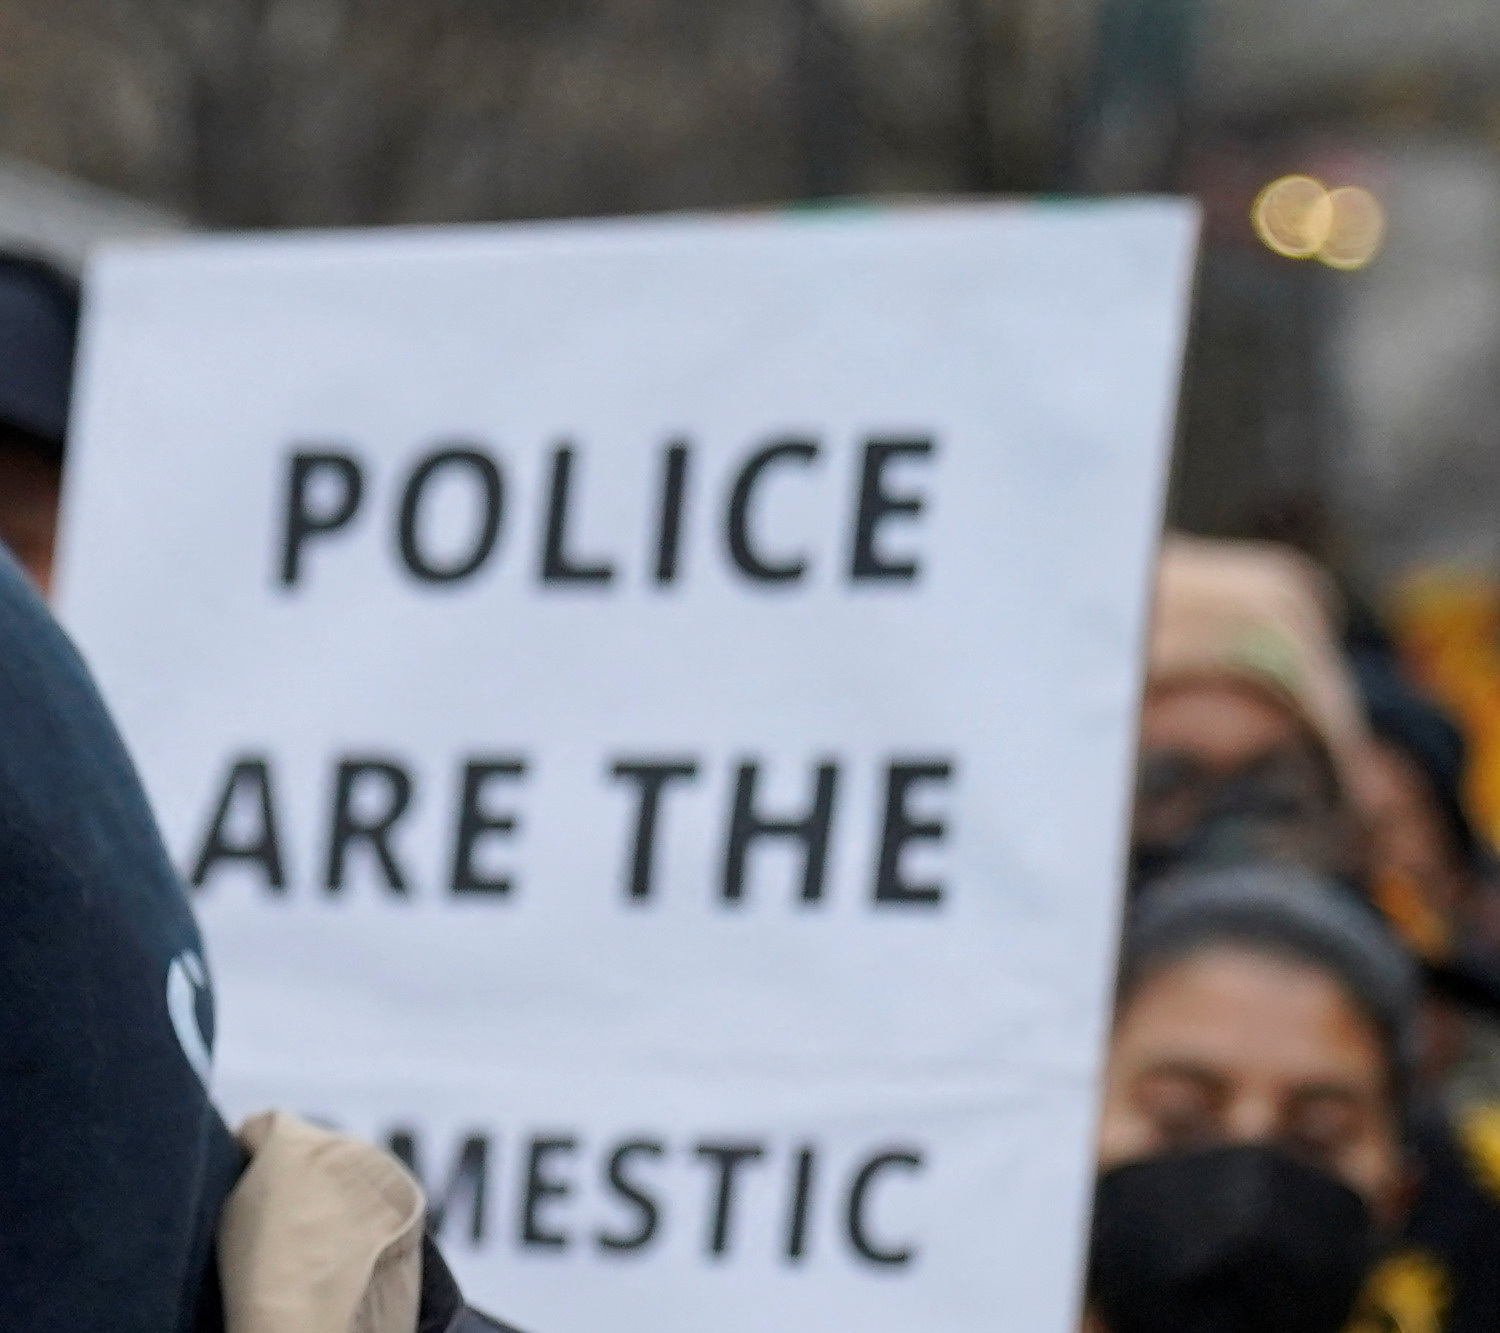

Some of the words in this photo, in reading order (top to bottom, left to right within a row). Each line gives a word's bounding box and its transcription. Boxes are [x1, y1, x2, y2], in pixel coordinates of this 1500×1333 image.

[277, 432, 936, 590] POLICE
[190, 754, 529, 898] ARE
[608, 757, 955, 908] THE
[384, 1128, 926, 1268] MESTIC
